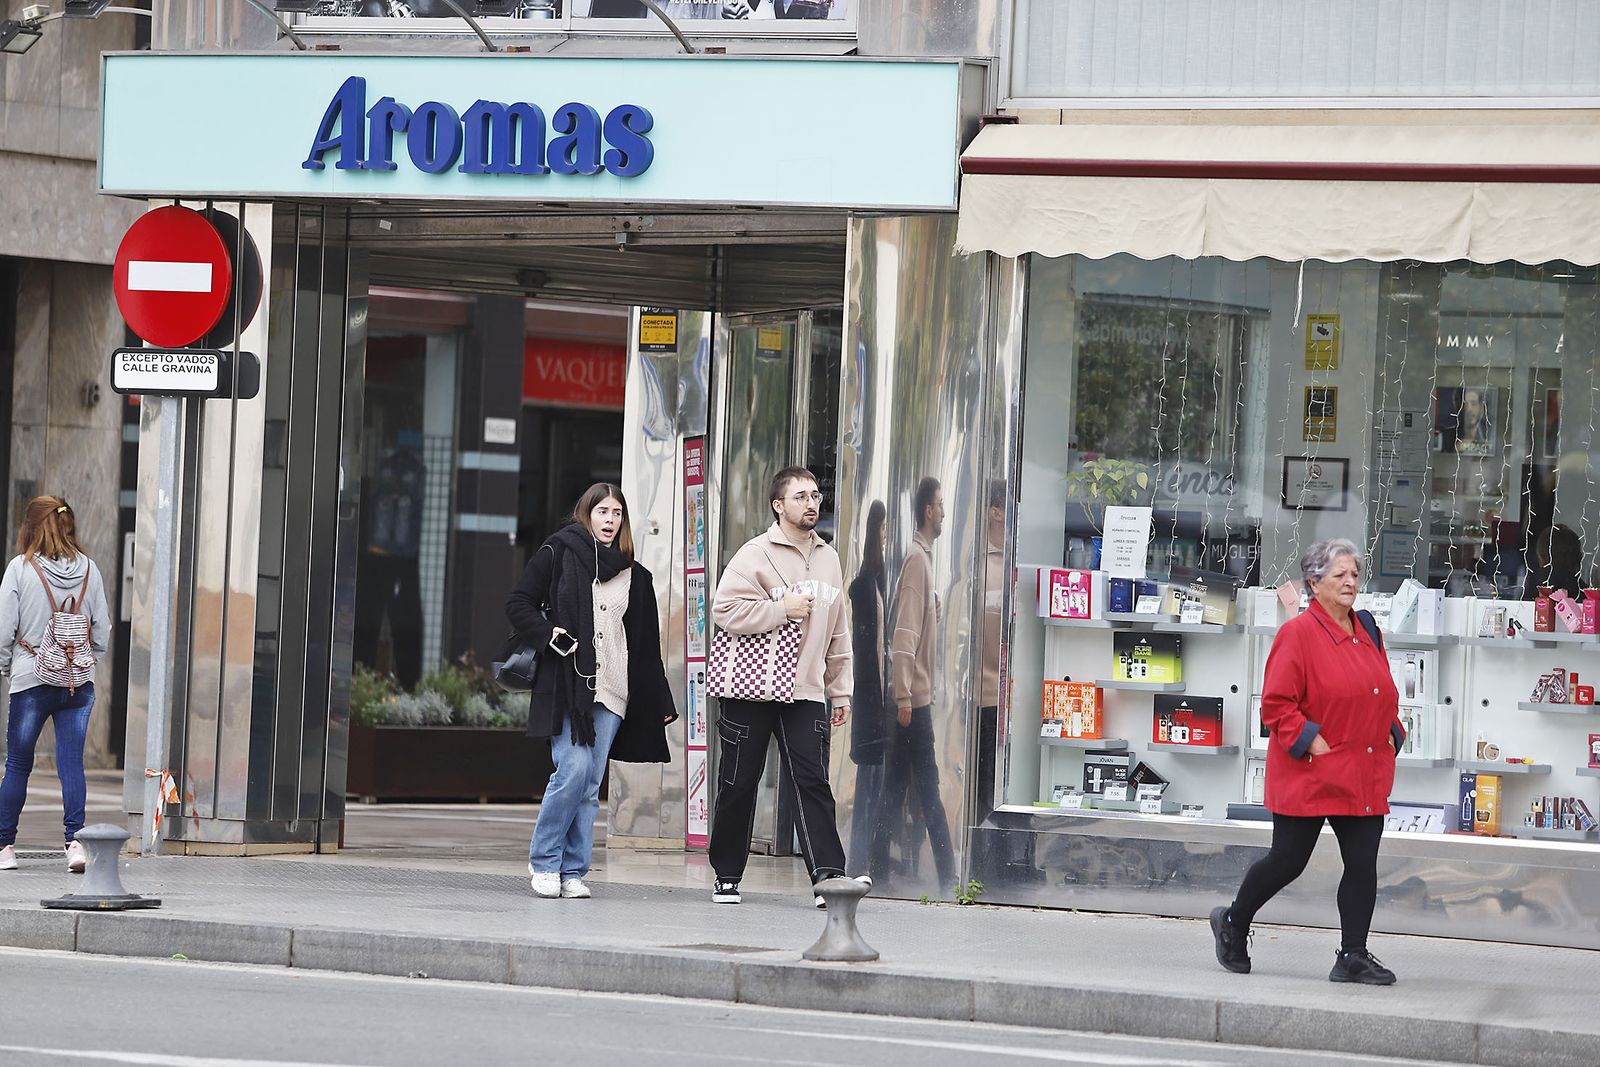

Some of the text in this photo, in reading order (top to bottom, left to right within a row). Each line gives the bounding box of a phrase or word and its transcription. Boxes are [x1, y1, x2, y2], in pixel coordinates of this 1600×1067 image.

[301, 76, 654, 177] Aromas
[122, 353, 215, 364] EXCEPTO VADOS
[122, 363, 212, 374] CALLE GRAVINA
[536, 355, 626, 391] VAQUE
